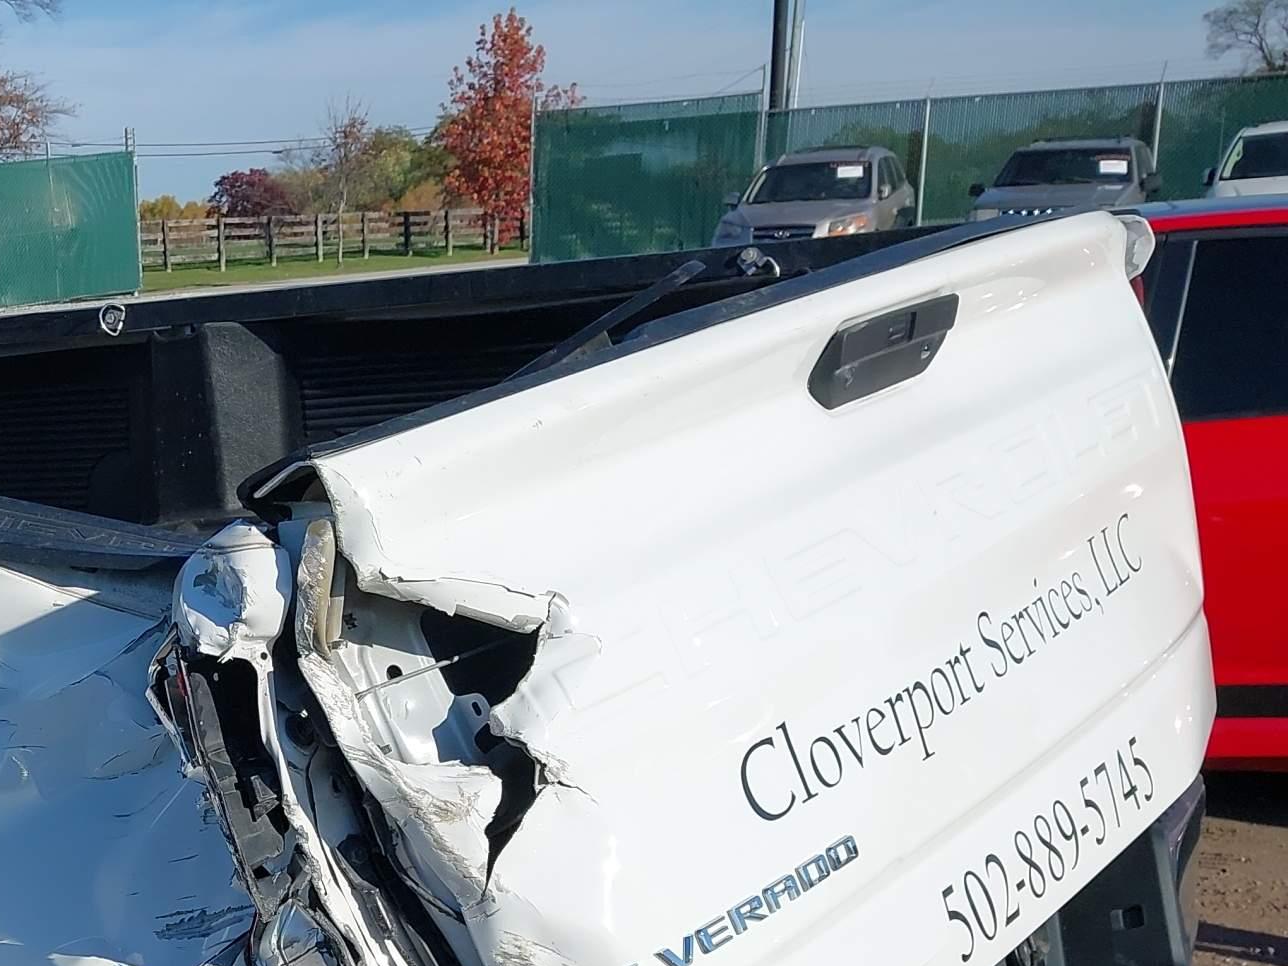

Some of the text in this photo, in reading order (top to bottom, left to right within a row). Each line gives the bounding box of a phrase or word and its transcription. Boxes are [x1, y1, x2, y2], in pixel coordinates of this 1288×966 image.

[739, 512, 1143, 822] Cloverport Services, LLC
[941, 735, 1156, 963] 502-889-5745
